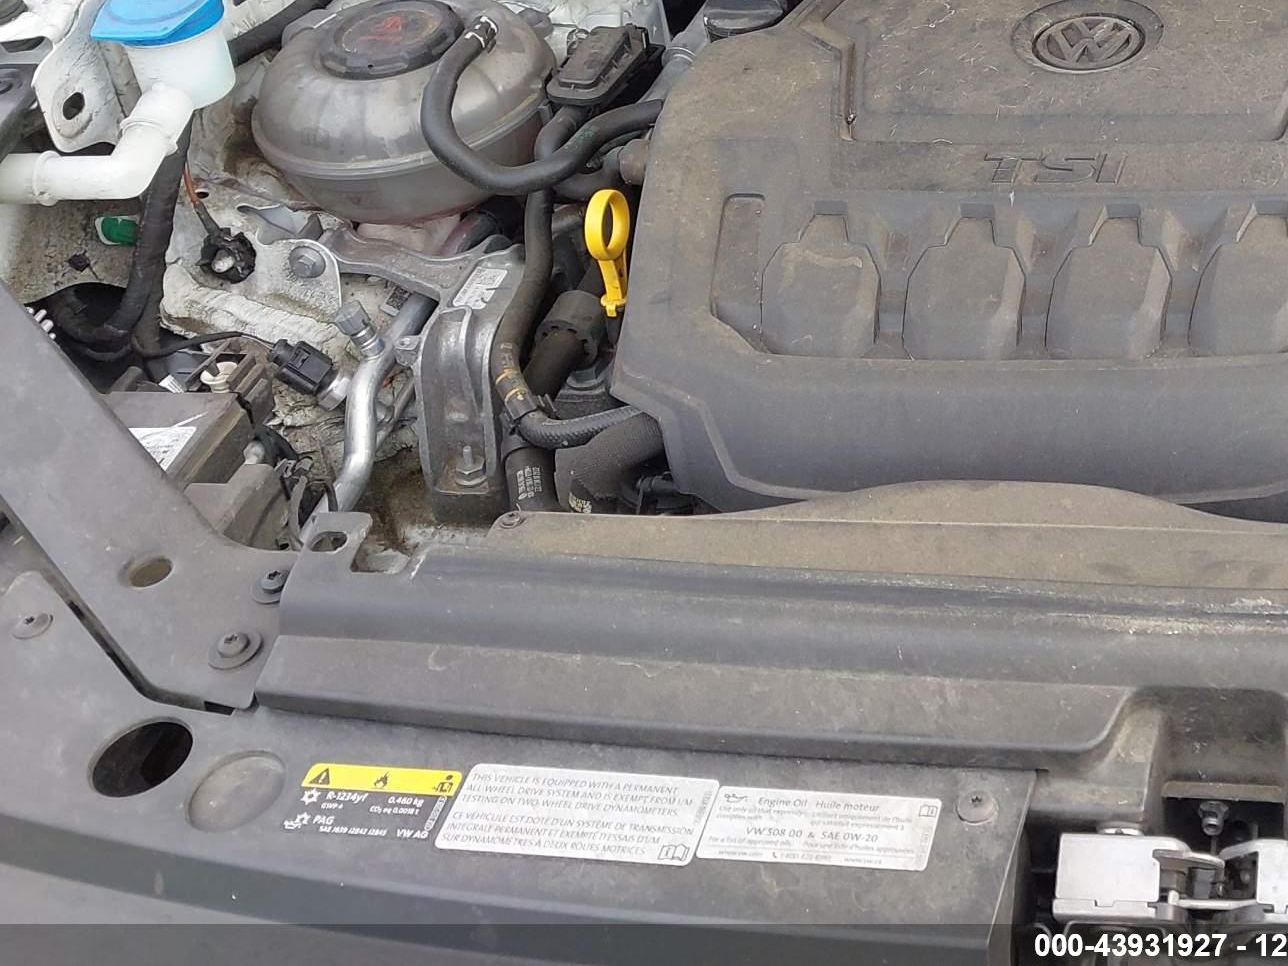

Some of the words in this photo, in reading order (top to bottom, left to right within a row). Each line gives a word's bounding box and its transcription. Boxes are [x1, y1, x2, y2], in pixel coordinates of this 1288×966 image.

[984, 153, 1128, 185] TSI
[473, 773, 492, 782] THIS
[494, 774, 529, 784] VEHICLE
[542, 777, 587, 788] EQUIPPED
[589, 780, 612, 789] WITH
[622, 783, 678, 794] PERMANENT
[326, 791, 369, 804] R-1234yf
[413, 797, 425, 807] kg
[462, 794, 499, 804] TESTING
[500, 796, 515, 805] ON
[574, 801, 602, 811] DRIVE
[485, 785, 514, 793] WHEEL
[517, 786, 544, 795] DRIVE
[547, 788, 579, 797] SYSTEM
[580, 791, 602, 799] AND
[612, 793, 648, 803] EXEMPT
[649, 795, 676, 805] FROM
[758, 797, 791, 808] Engine
[793, 798, 808, 807] Oil
[815, 800, 842, 810] Huile
[843, 802, 880, 812] moteur
[312, 815, 335, 825] PAG
[509, 814, 525, 823] EST
[629, 823, 694, 835] TRANSMISSION
[396, 829, 415, 838] VW
[413, 830, 429, 839] AG
[746, 826, 767, 835] VW
[768, 827, 787, 836] 508
[788, 829, 803, 837] 00
[820, 831, 841, 840] SAE
[843, 832, 879, 842] 0W-20
[442, 833, 459, 842] SUR
[570, 841, 600, 851] ROUES
[601, 843, 646, 855] MOTRICES
